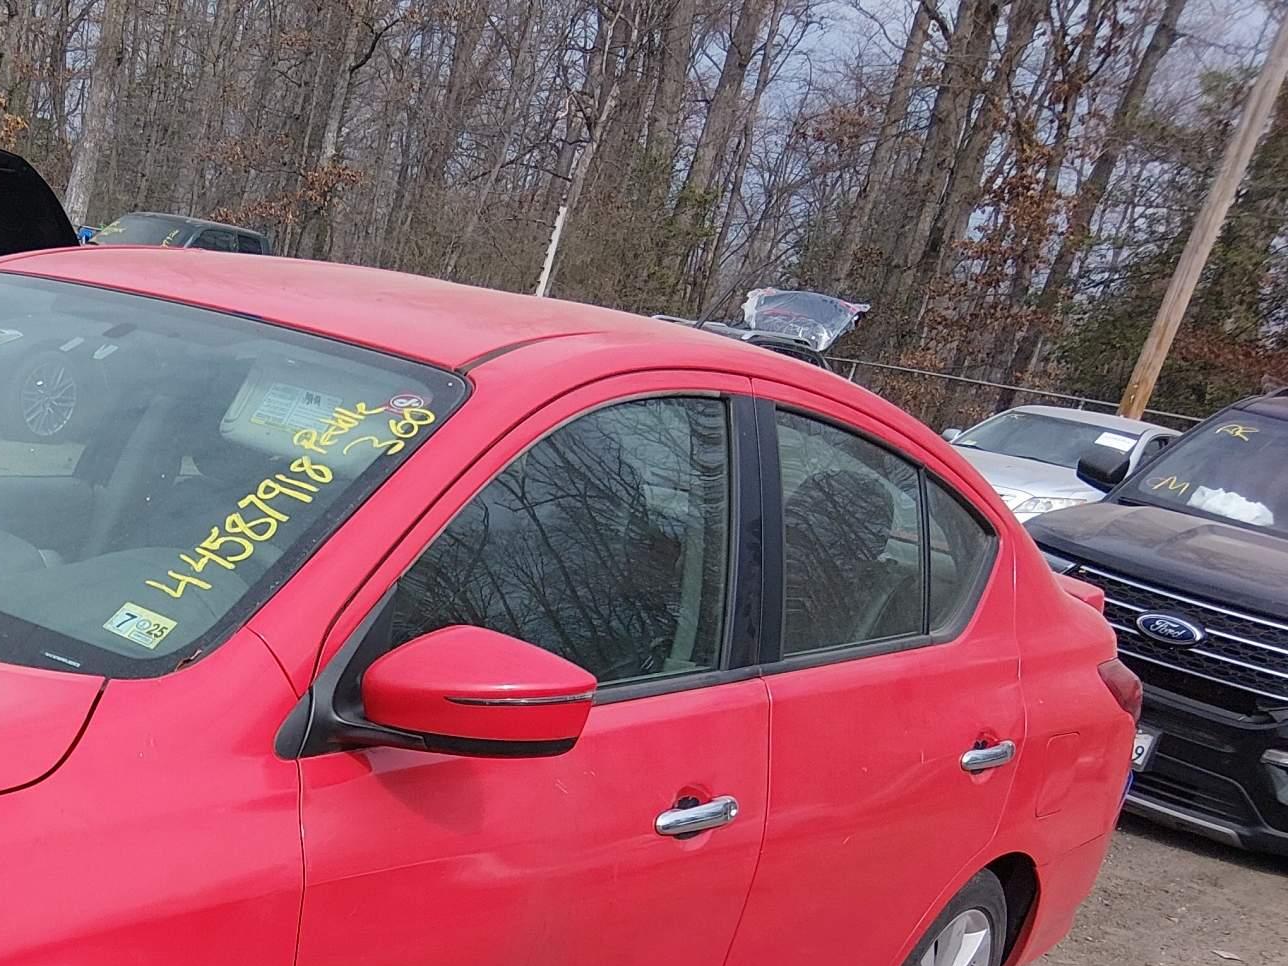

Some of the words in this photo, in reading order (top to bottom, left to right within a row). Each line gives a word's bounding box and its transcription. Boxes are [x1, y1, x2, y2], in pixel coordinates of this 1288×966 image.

[343, 408, 436, 456] 360
[145, 455, 334, 598] 44587918
[116, 612, 138, 628] 7
[146, 623, 169, 639] 25
[1149, 619, 1186, 639] Ford
